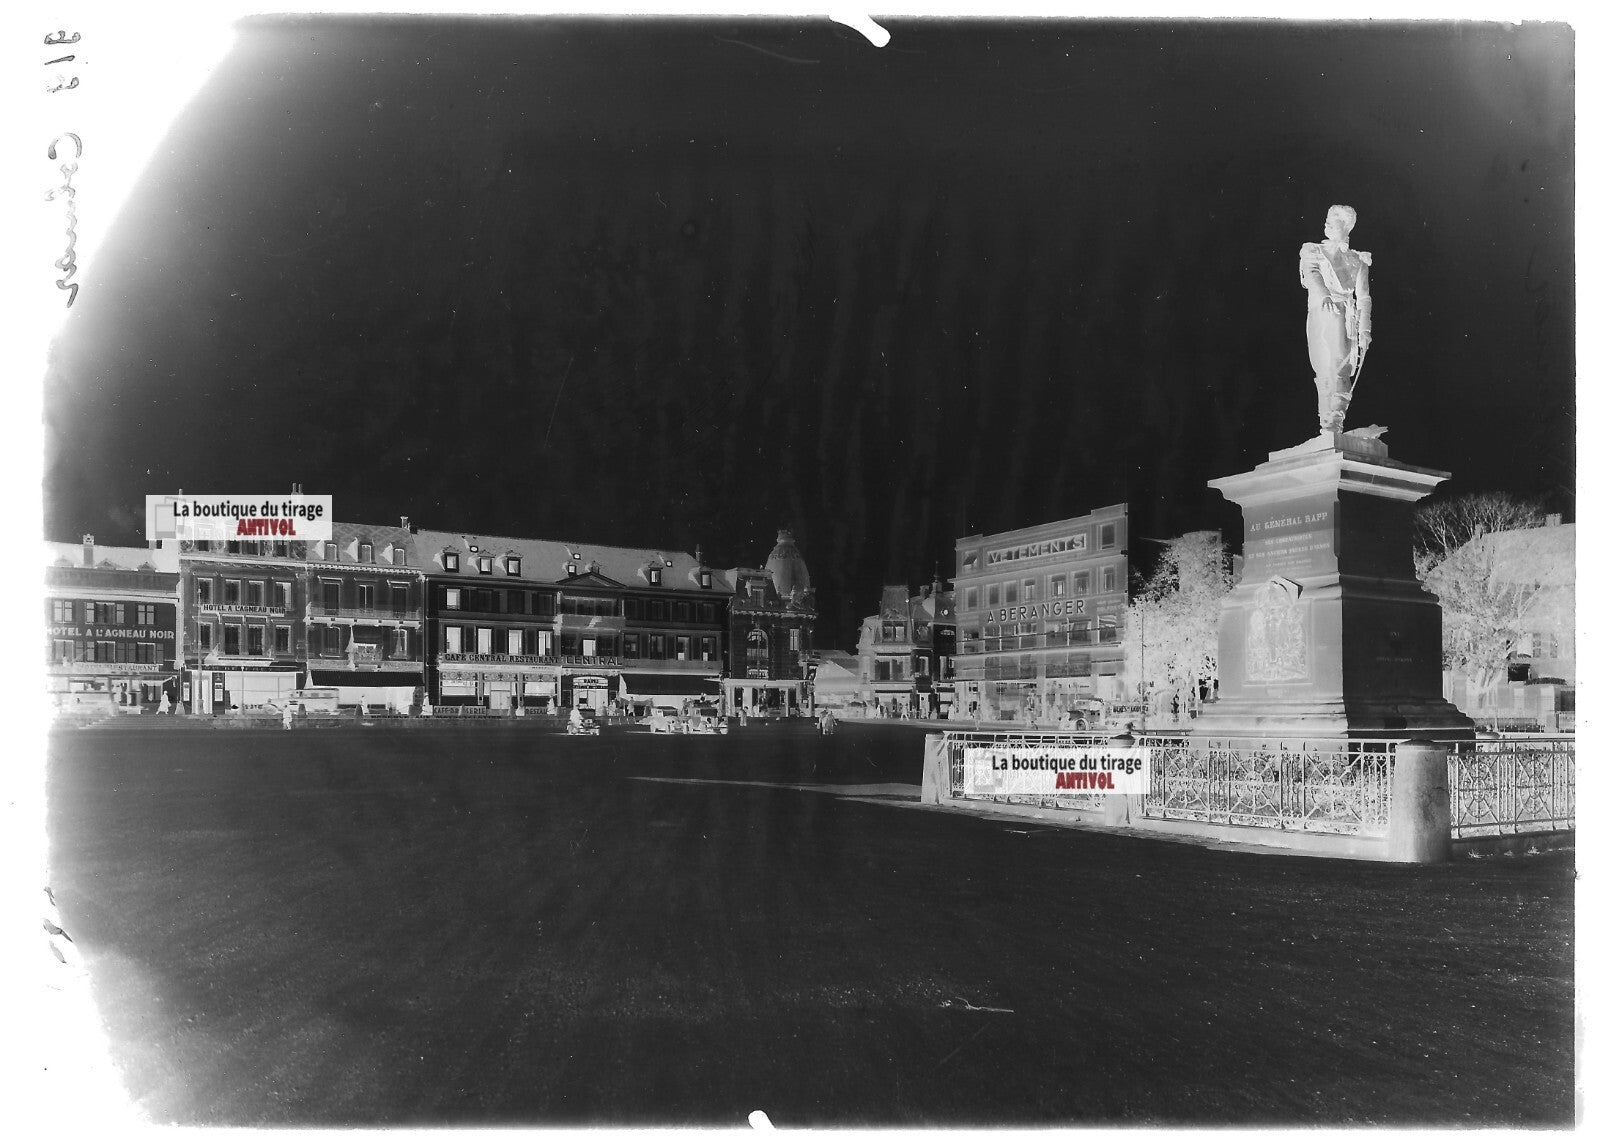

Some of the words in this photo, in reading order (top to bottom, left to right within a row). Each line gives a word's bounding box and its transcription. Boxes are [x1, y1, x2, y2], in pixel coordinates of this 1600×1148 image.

[1249, 523, 1261, 532] AU
[1305, 512, 1328, 523] RAPP
[987, 611, 995, 624] A
[999, 599, 1085, 622] BERANGER
[85, 628, 93, 637] A
[96, 628, 146, 638] L'AGNEAU
[149, 630, 175, 639] NOIR
[469, 654, 507, 663] CENTRAL
[509, 655, 559, 664] RESTAURANT
[565, 656, 623, 667] CENTRAL
